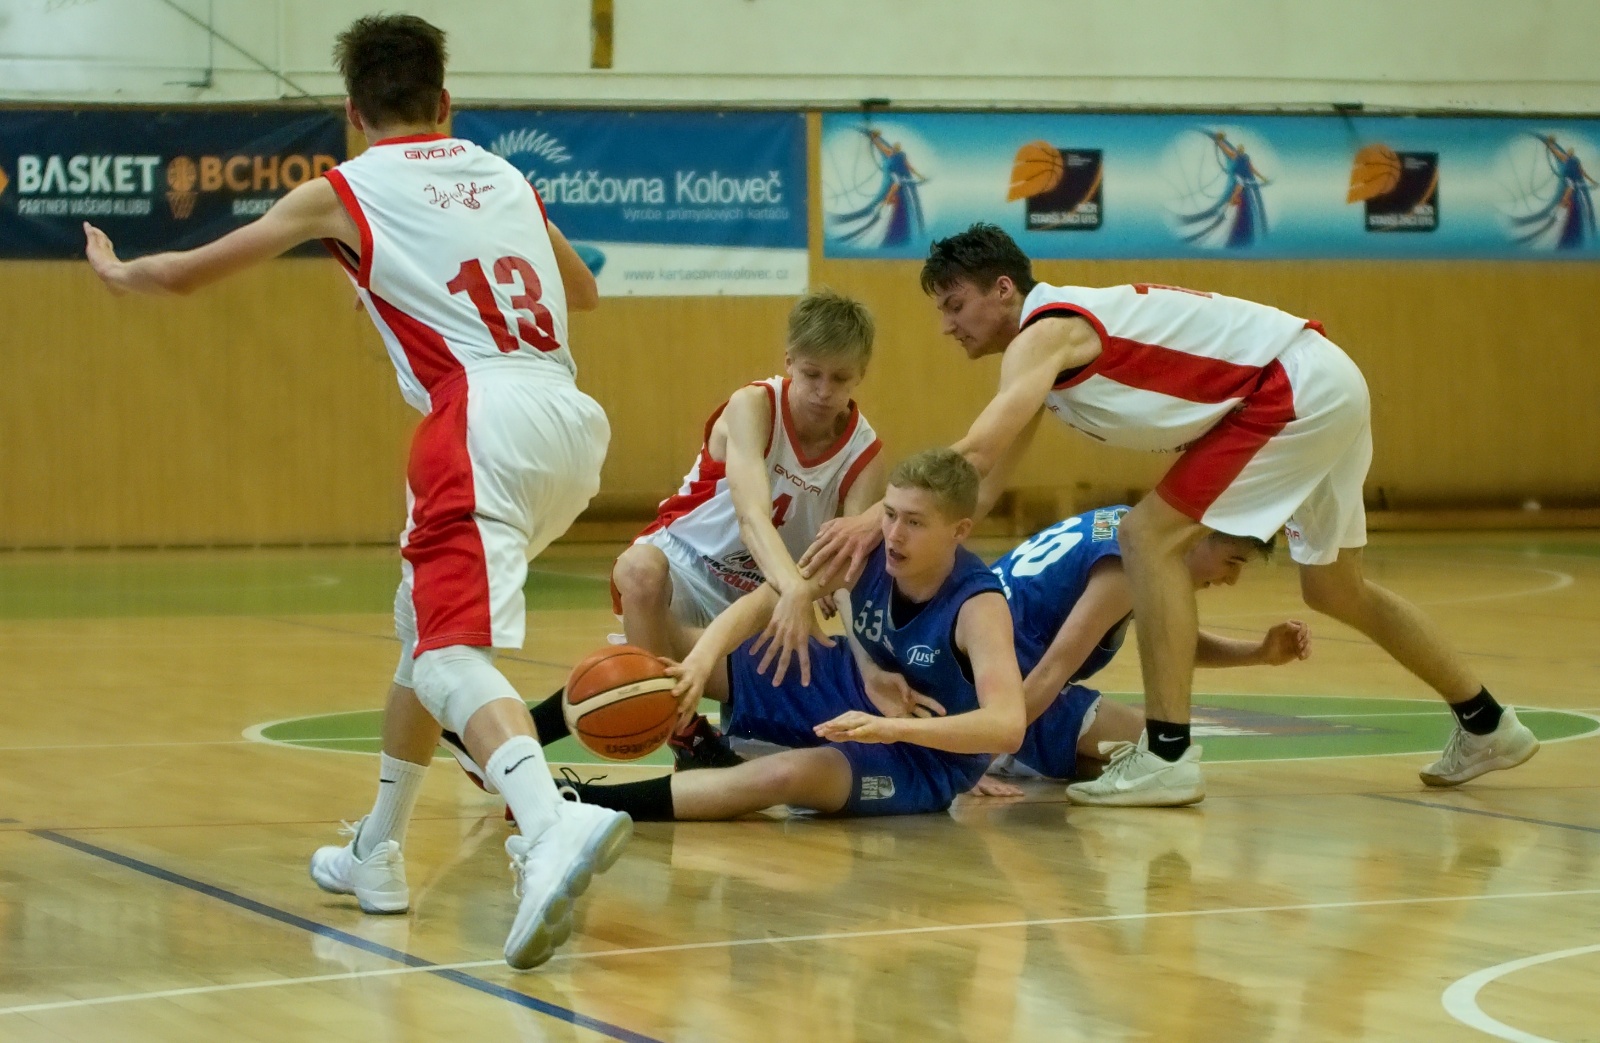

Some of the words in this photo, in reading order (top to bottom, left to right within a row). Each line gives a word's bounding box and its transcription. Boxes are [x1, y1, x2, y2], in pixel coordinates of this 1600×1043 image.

[404, 145, 467, 160] GIVOVA
[18, 154, 161, 193] BASKET
[527, 170, 666, 203] artáčovna
[675, 170, 782, 203] Koloveč
[446, 256, 561, 353] 13
[853, 600, 884, 643] 53
[907, 648, 936, 665] Just
